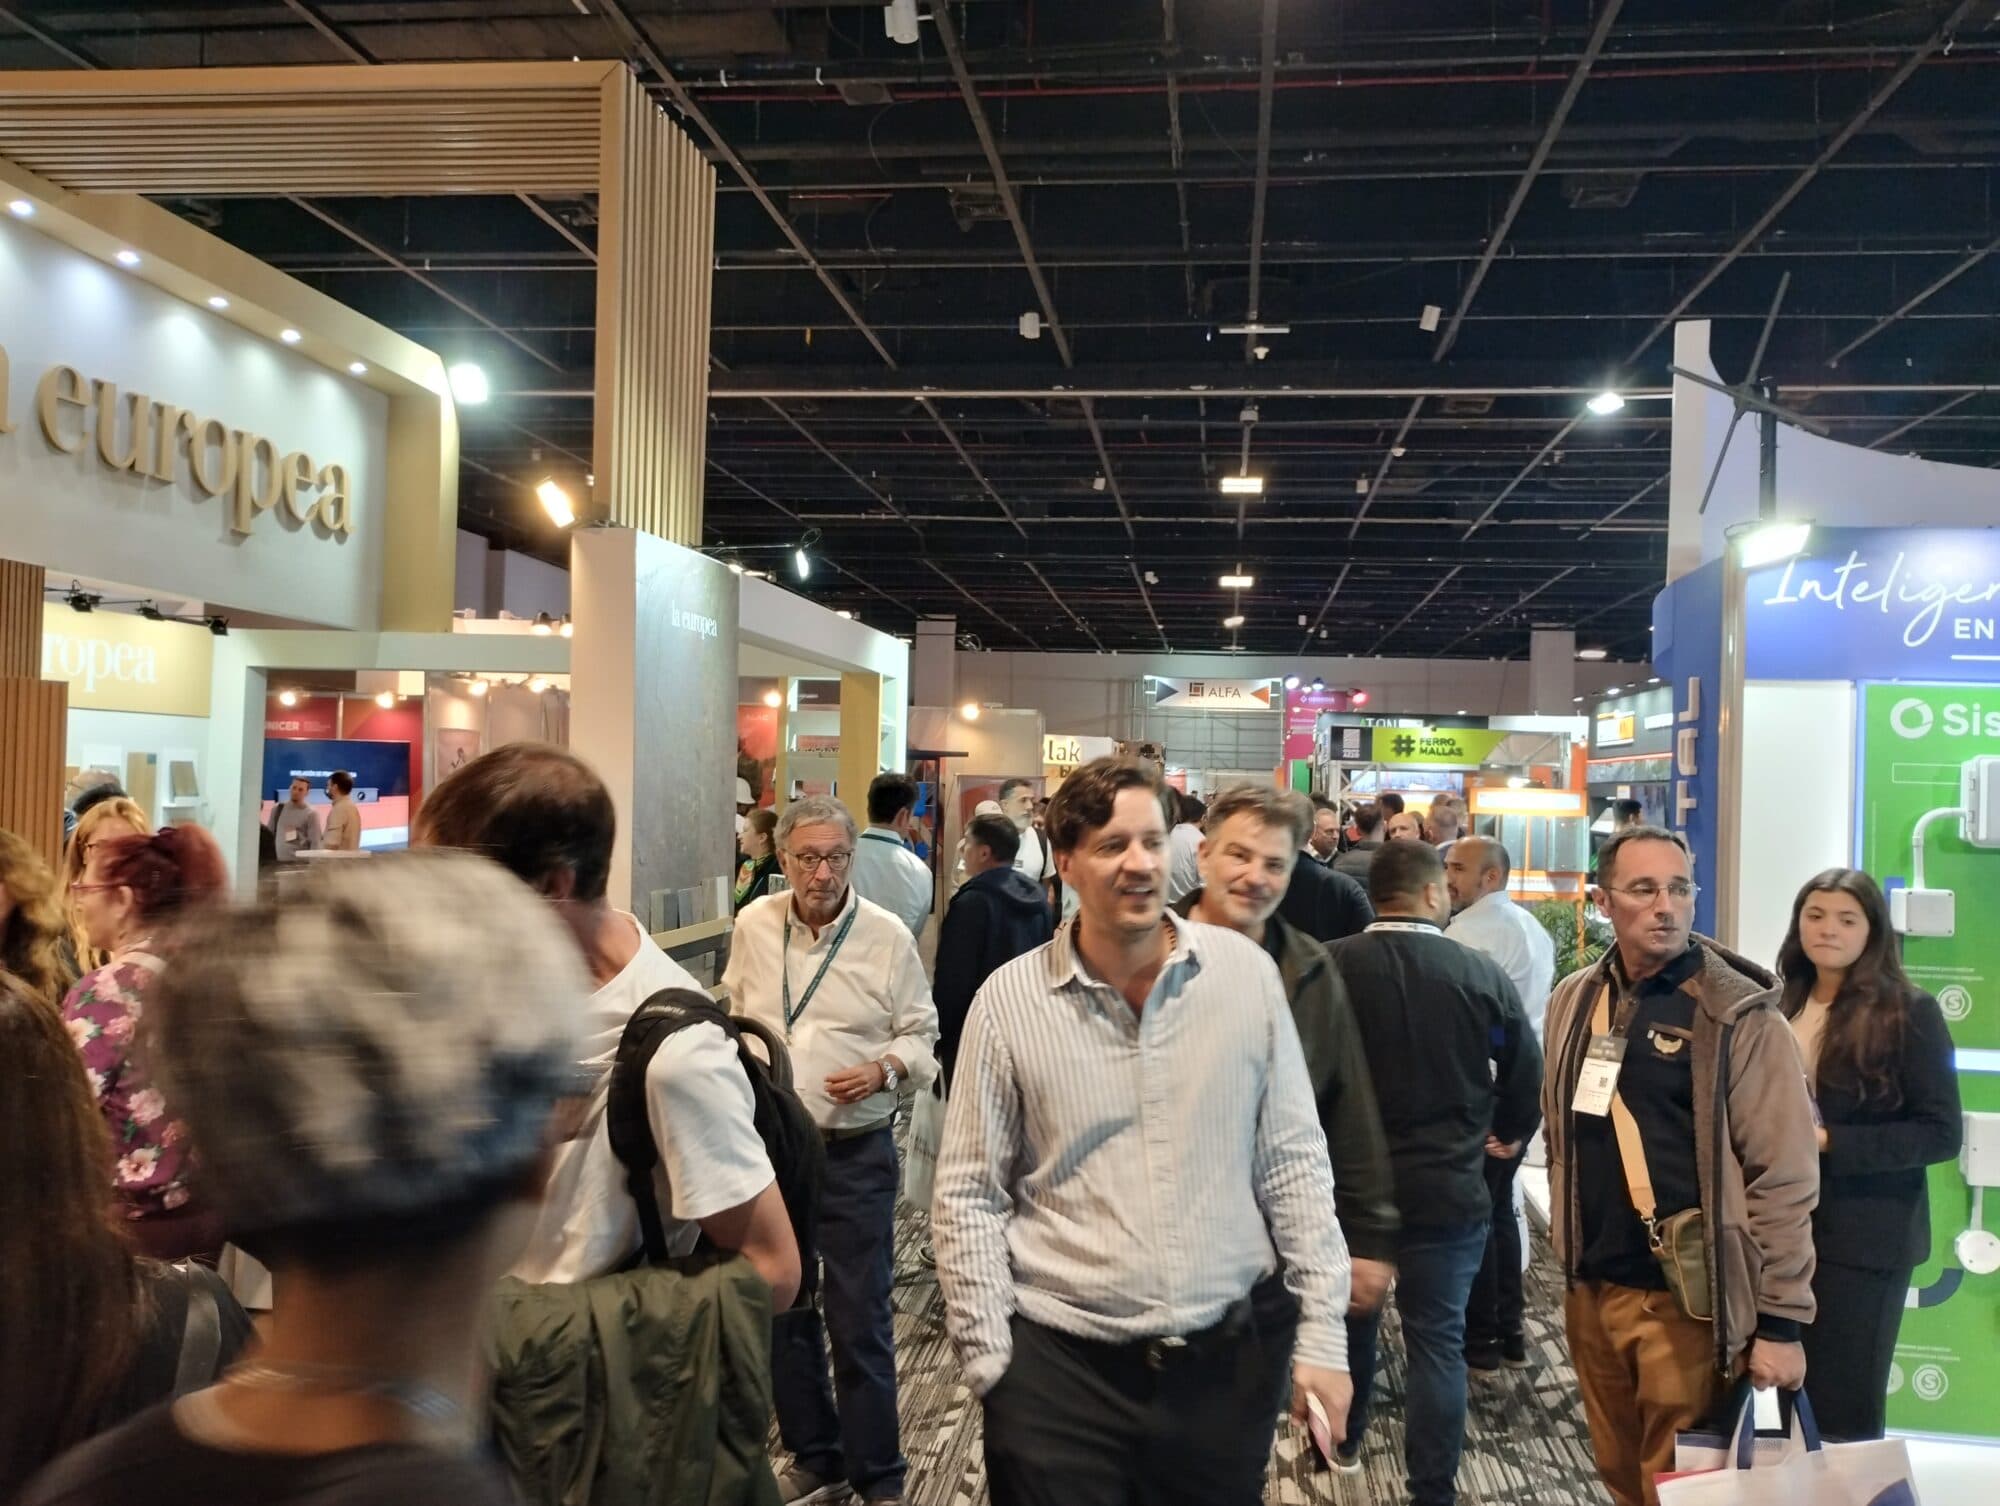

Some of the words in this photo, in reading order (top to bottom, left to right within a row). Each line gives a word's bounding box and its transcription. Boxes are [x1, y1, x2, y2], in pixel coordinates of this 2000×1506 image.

[37, 364, 354, 536] europea
[682, 610, 718, 640] europea
[1954, 617, 1994, 639] EN
[1208, 686, 1241, 698] ALFA
[1419, 737, 1457, 747] FERRO
[1419, 747, 1464, 757] MALLAS
